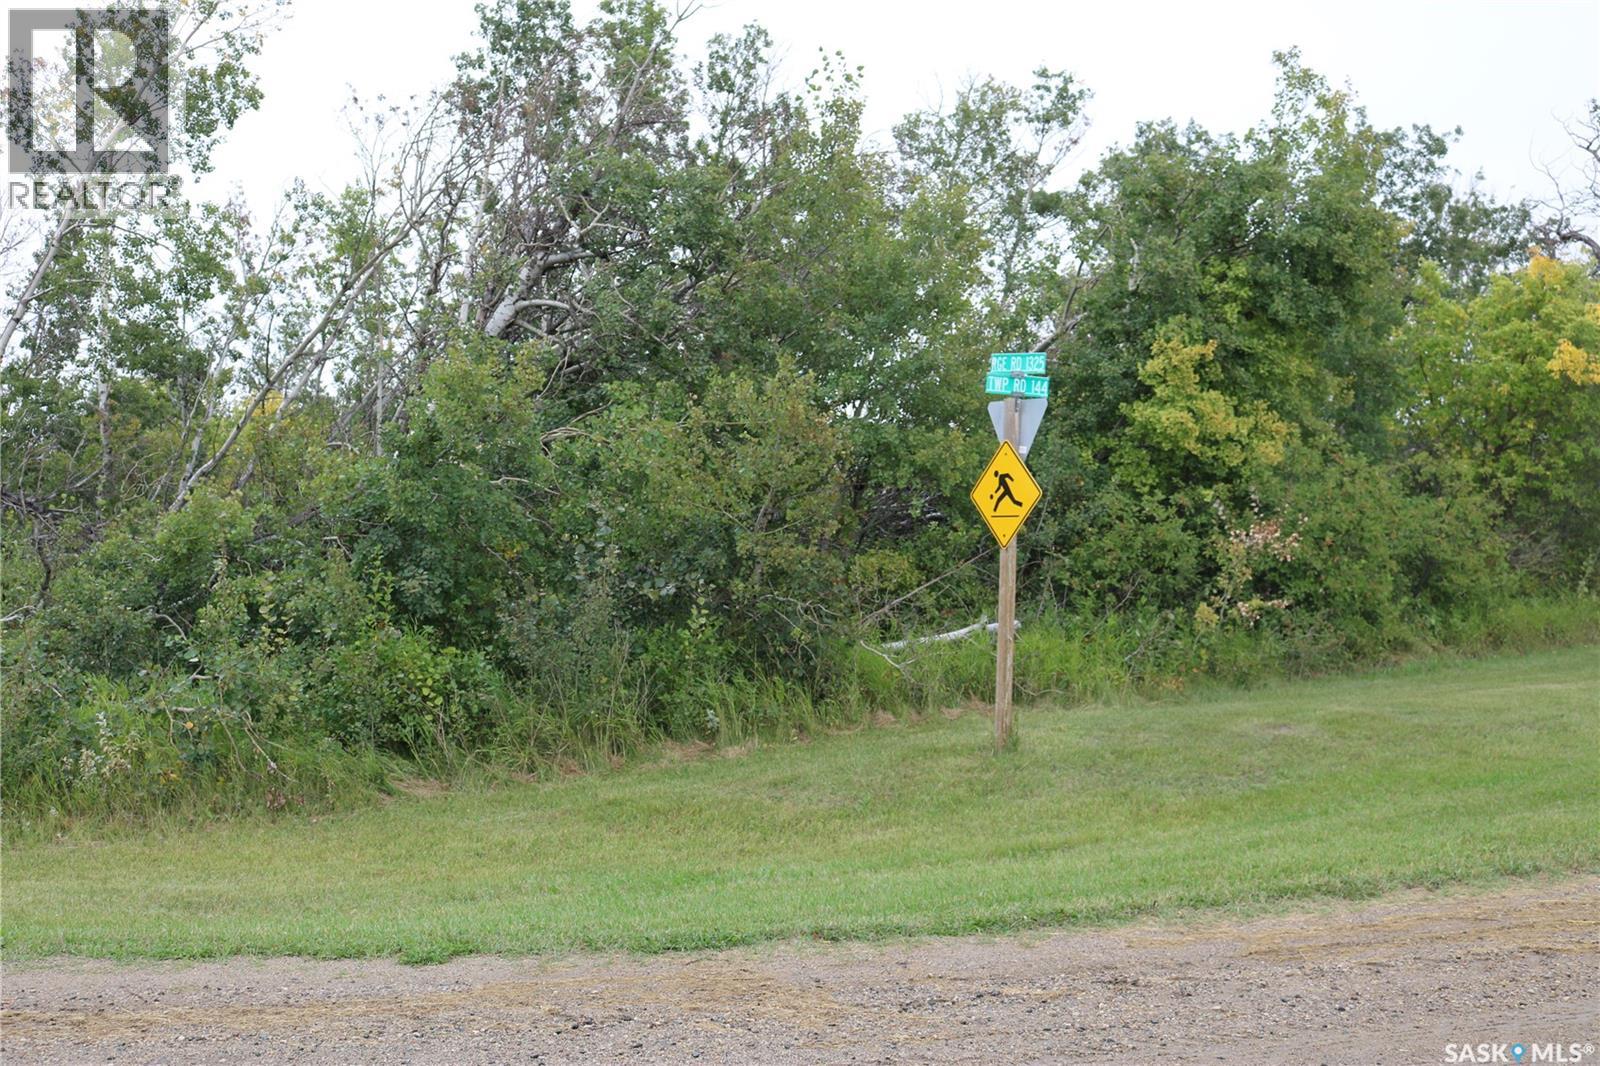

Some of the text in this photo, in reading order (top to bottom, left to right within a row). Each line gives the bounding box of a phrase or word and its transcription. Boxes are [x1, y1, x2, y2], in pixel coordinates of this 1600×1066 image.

[991, 355, 1045, 371] RGE RD 1325
[988, 376, 1048, 395] TWP RD 144
